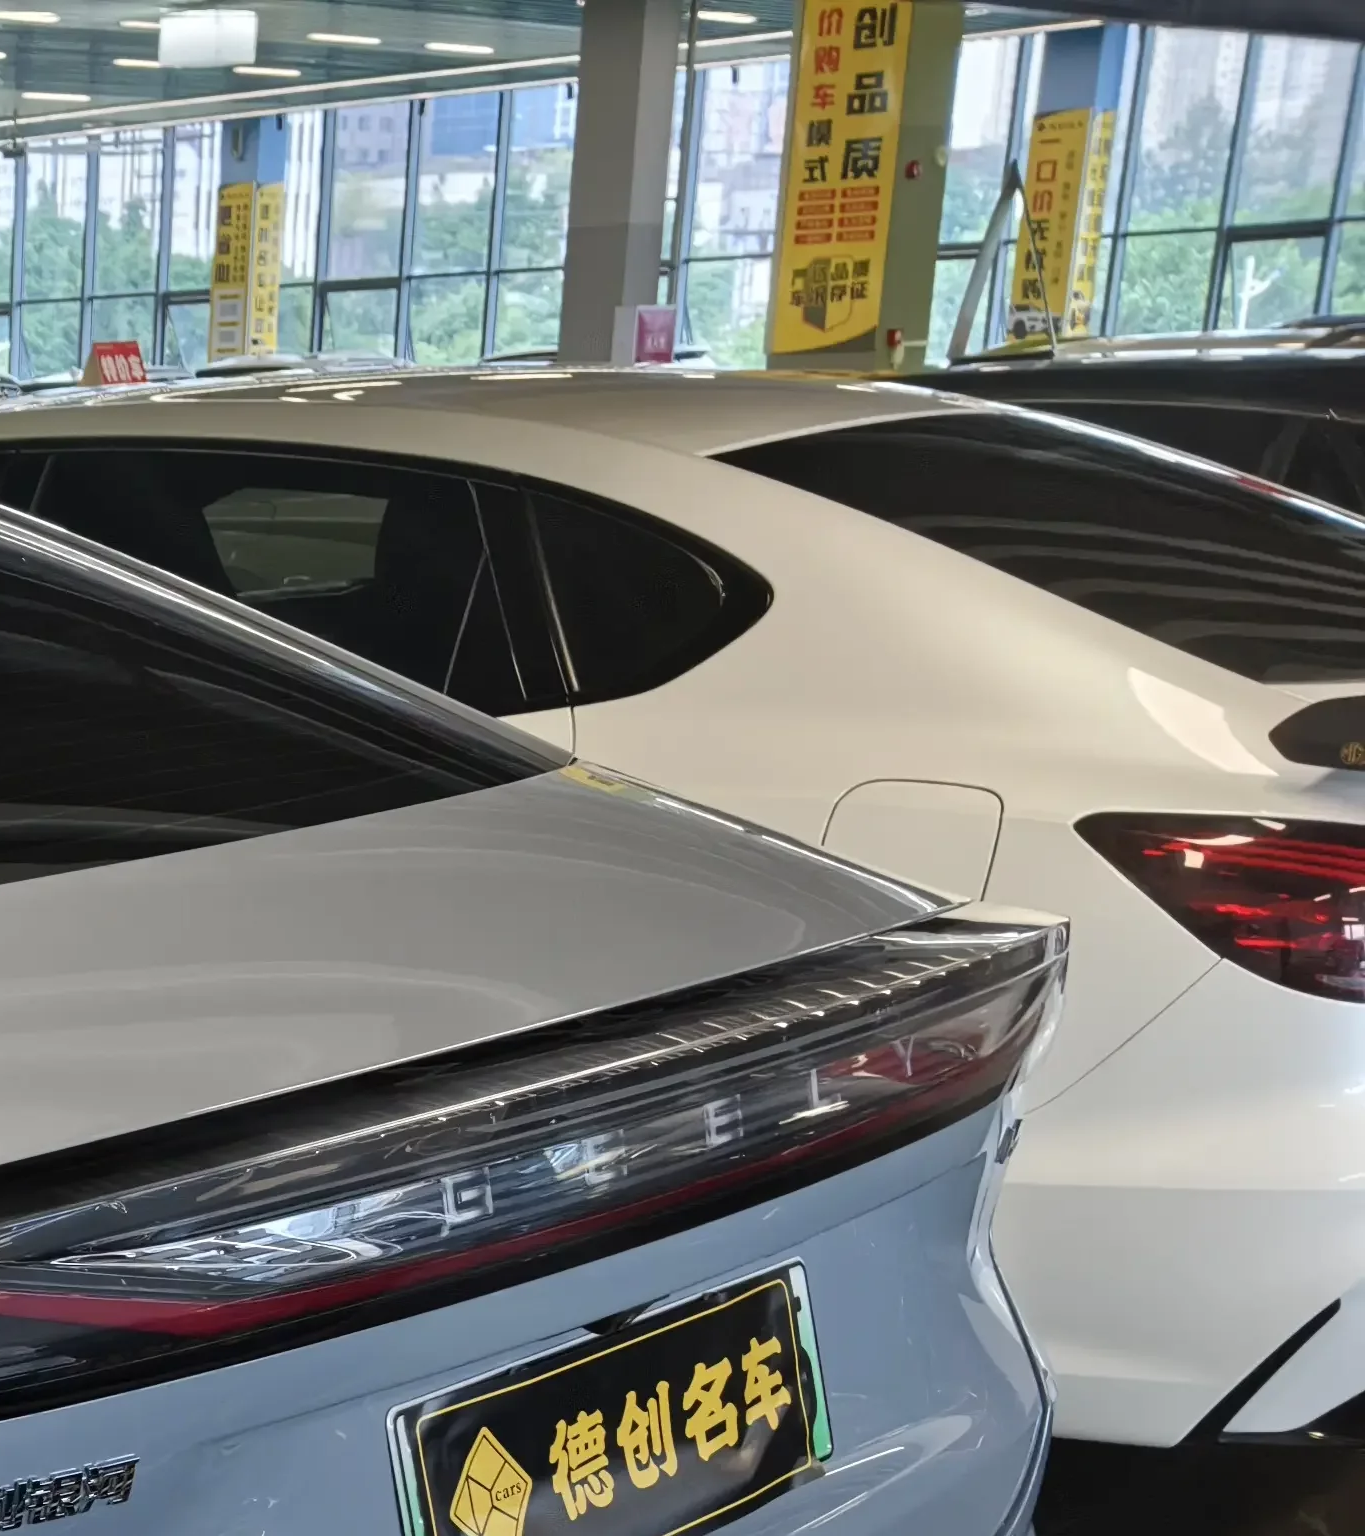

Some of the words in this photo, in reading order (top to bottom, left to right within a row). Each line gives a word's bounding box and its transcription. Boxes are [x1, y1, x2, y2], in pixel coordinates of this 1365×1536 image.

[802, 7, 844, 184] 价购车模式
[841, 2, 898, 181] 创品质
[441, 1034, 914, 1237] GEELY
[495, 1482, 522, 1502] cars
[547, 1336, 794, 1522] 德创名车
